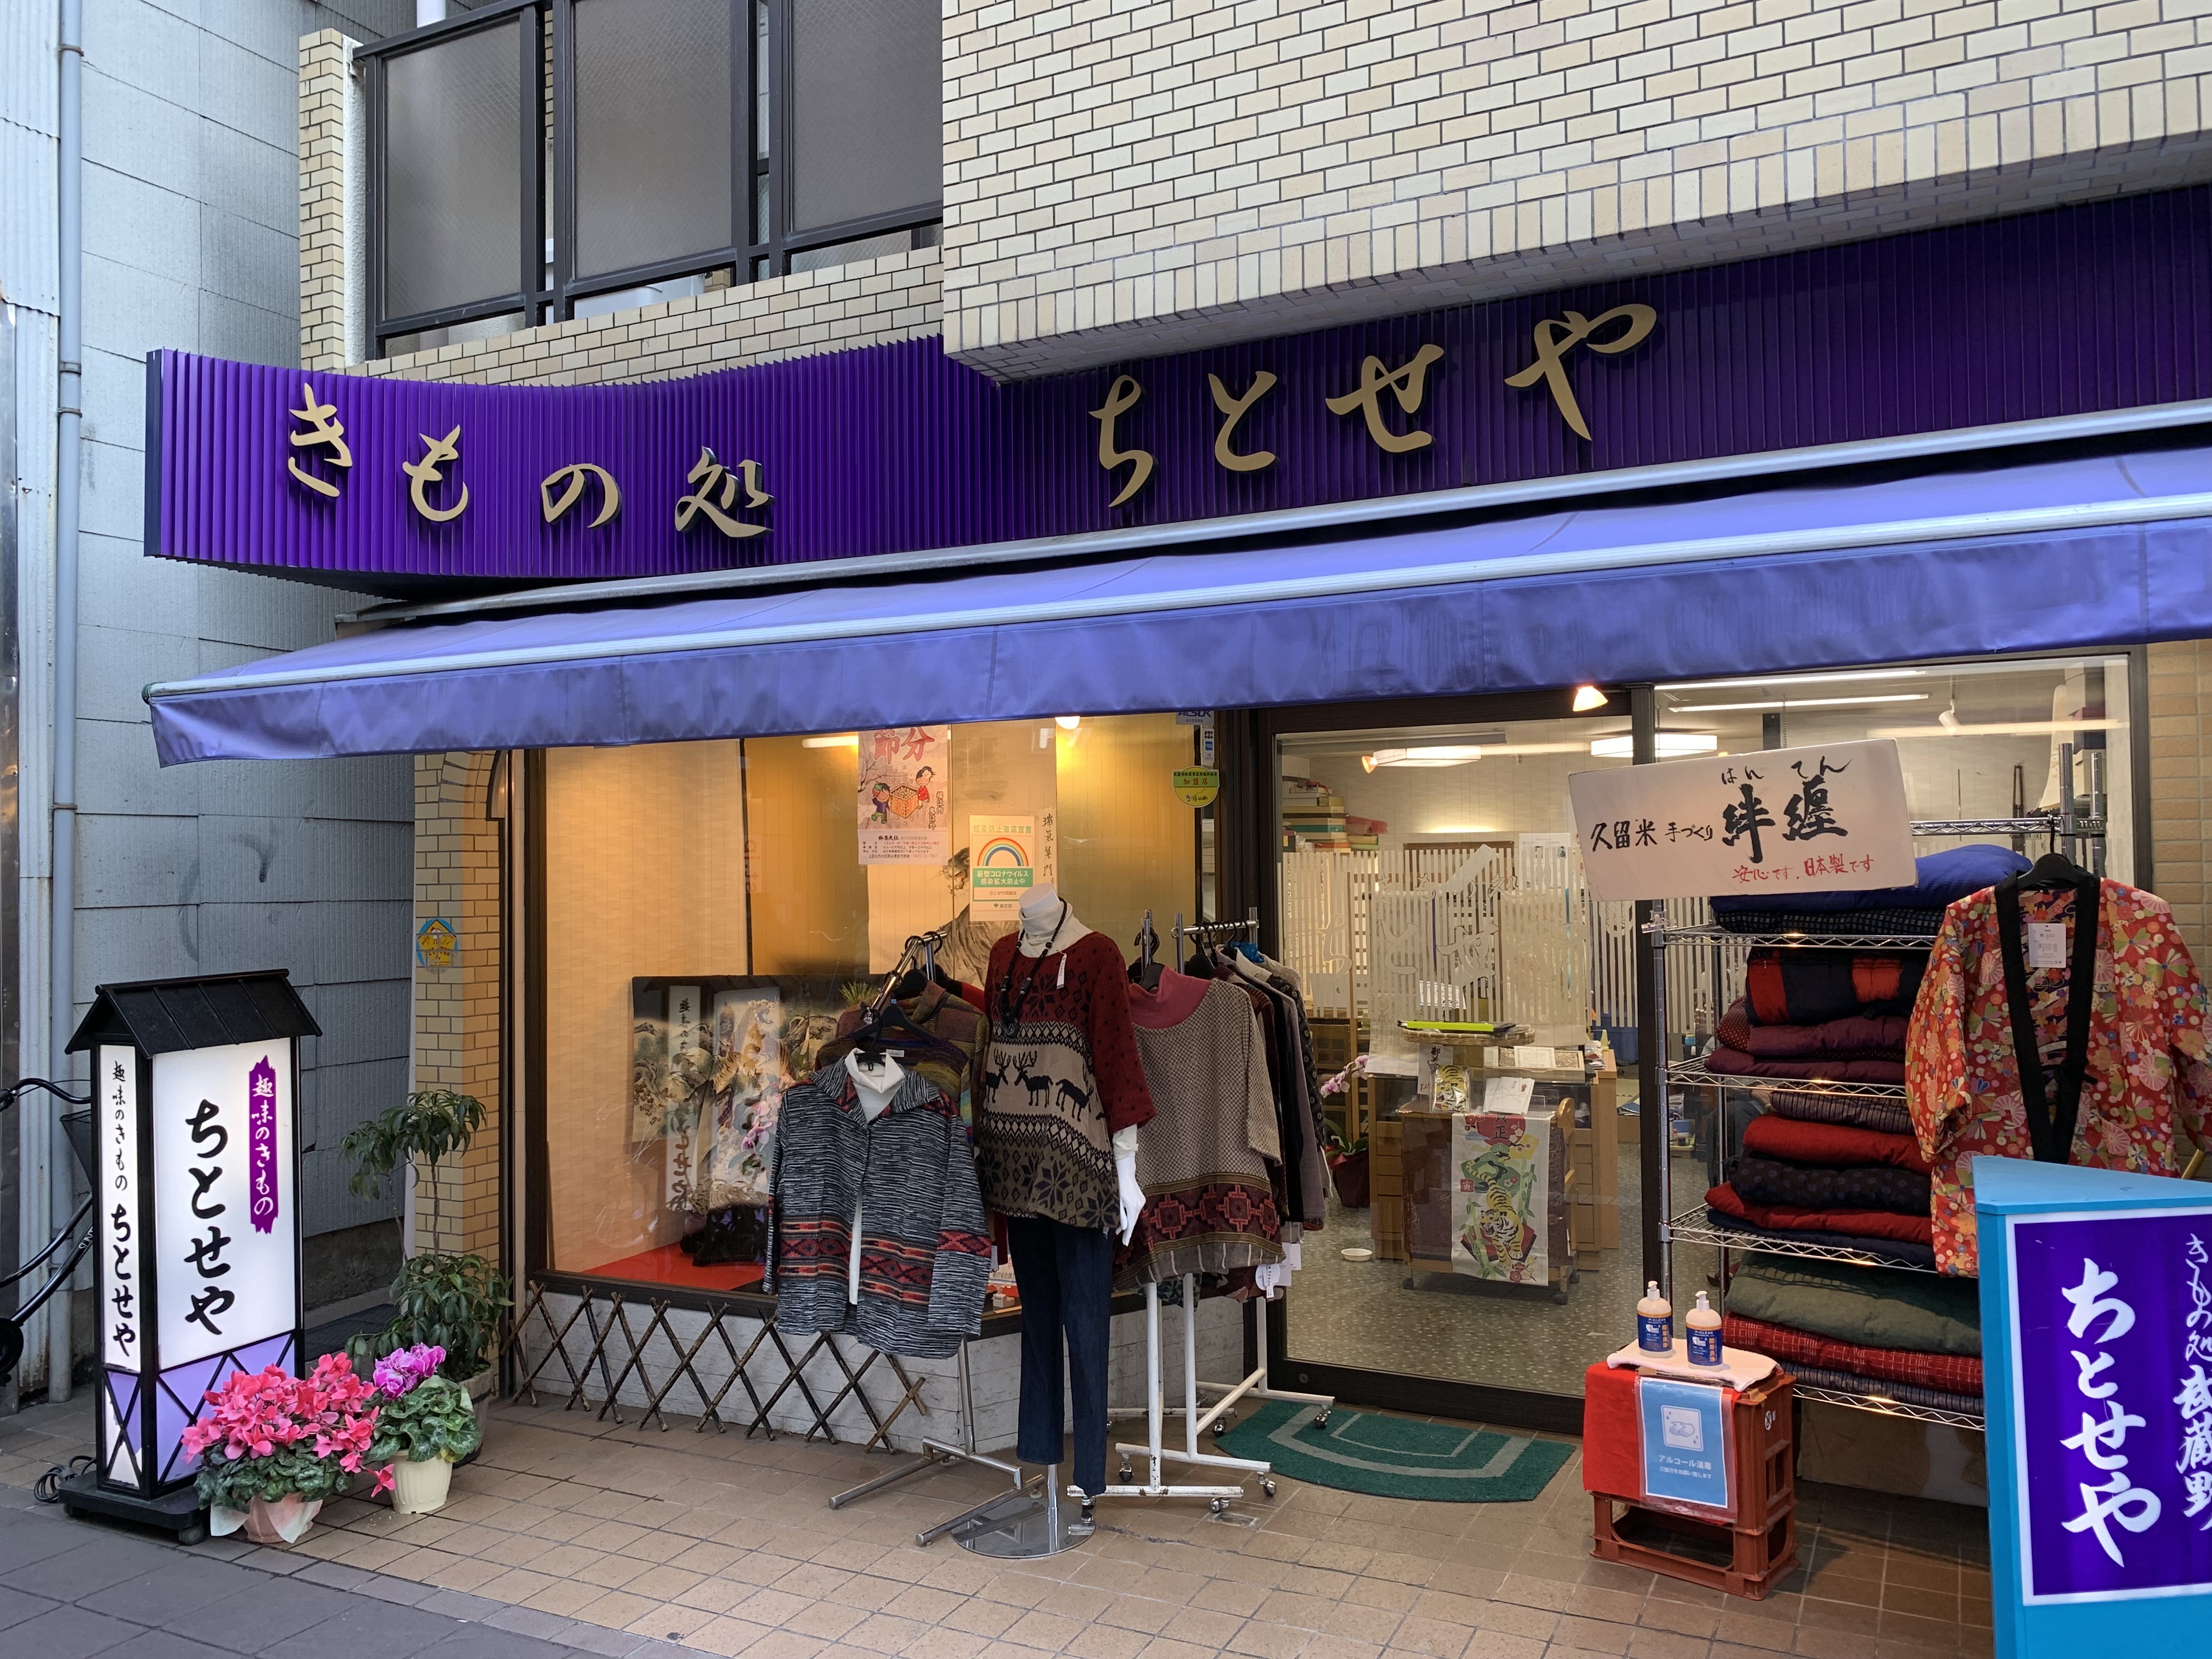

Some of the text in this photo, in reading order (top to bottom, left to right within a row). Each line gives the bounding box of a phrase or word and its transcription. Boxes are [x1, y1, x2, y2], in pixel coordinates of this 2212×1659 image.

[288, 303, 1657, 538] きもの処 ちとせや
[974, 825, 1031, 833] 感染防止徹底宣言
[1590, 819, 1657, 853] 久留米
[1664, 822, 1713, 842] 手づくり
[1804, 854, 1874, 878] 日本製です
[111, 1060, 136, 1357] 趣味のきもの ちとせや
[251, 1074, 274, 1215] 趣味のきもの
[184, 1099, 235, 1335] ちとせや
[1658, 1455, 1712, 1470] アルコール消毒
[2061, 1257, 2161, 1567] ちとせや
